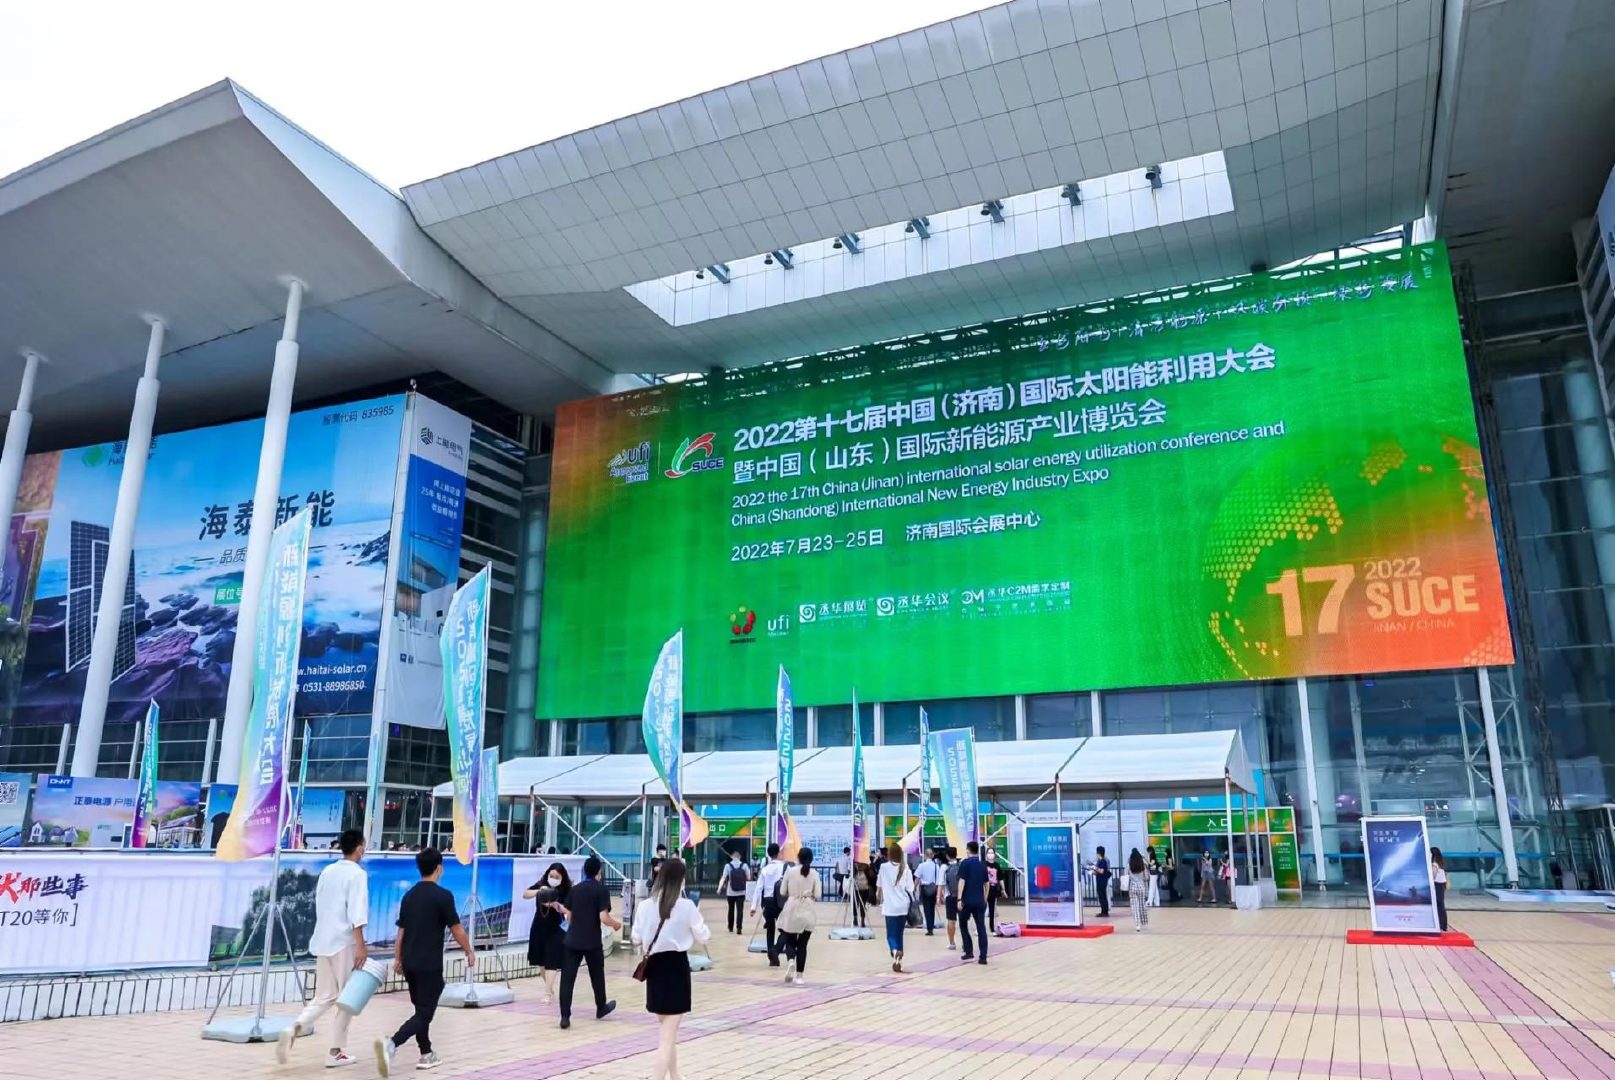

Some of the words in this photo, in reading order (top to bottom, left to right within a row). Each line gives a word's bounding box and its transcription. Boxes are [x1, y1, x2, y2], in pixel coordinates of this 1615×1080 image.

[361, 405, 394, 419] 835985
[734, 342, 1276, 452] 2022第十七届中国（济南）国际太阳能利用大会
[692, 458, 725, 472] SUCE
[732, 491, 765, 509] 2022
[768, 490, 788, 503] the
[791, 486, 820, 498] 17th
[822, 482, 859, 496] China
[861, 475, 904, 492] (Jinan)
[907, 461, 992, 485] international
[995, 457, 1028, 472] solar
[1033, 450, 1082, 468] energy
[1085, 439, 1157, 460] utilization
[1160, 427, 1249, 450] conference
[1252, 421, 1285, 438] and
[733, 398, 1167, 484] 暨中国（山东）国际新能源产业博览会
[731, 513, 766, 527] China
[767, 503, 839, 525] (Shandong)
[842, 490, 924, 512] International
[927, 485, 958, 500] New
[961, 479, 1008, 497] Energy
[1012, 472, 1070, 491] Industry
[1073, 468, 1109, 484] Expo
[731, 529, 883, 562] 2022年7月23-25日
[906, 510, 1041, 542] 济南国际会展中心
[1364, 556, 1422, 580] 2022
[1266, 564, 1355, 636] 17
[1365, 575, 1480, 620] SUCE
[767, 614, 790, 631] ufi
[709, 824, 726, 832] 出口
